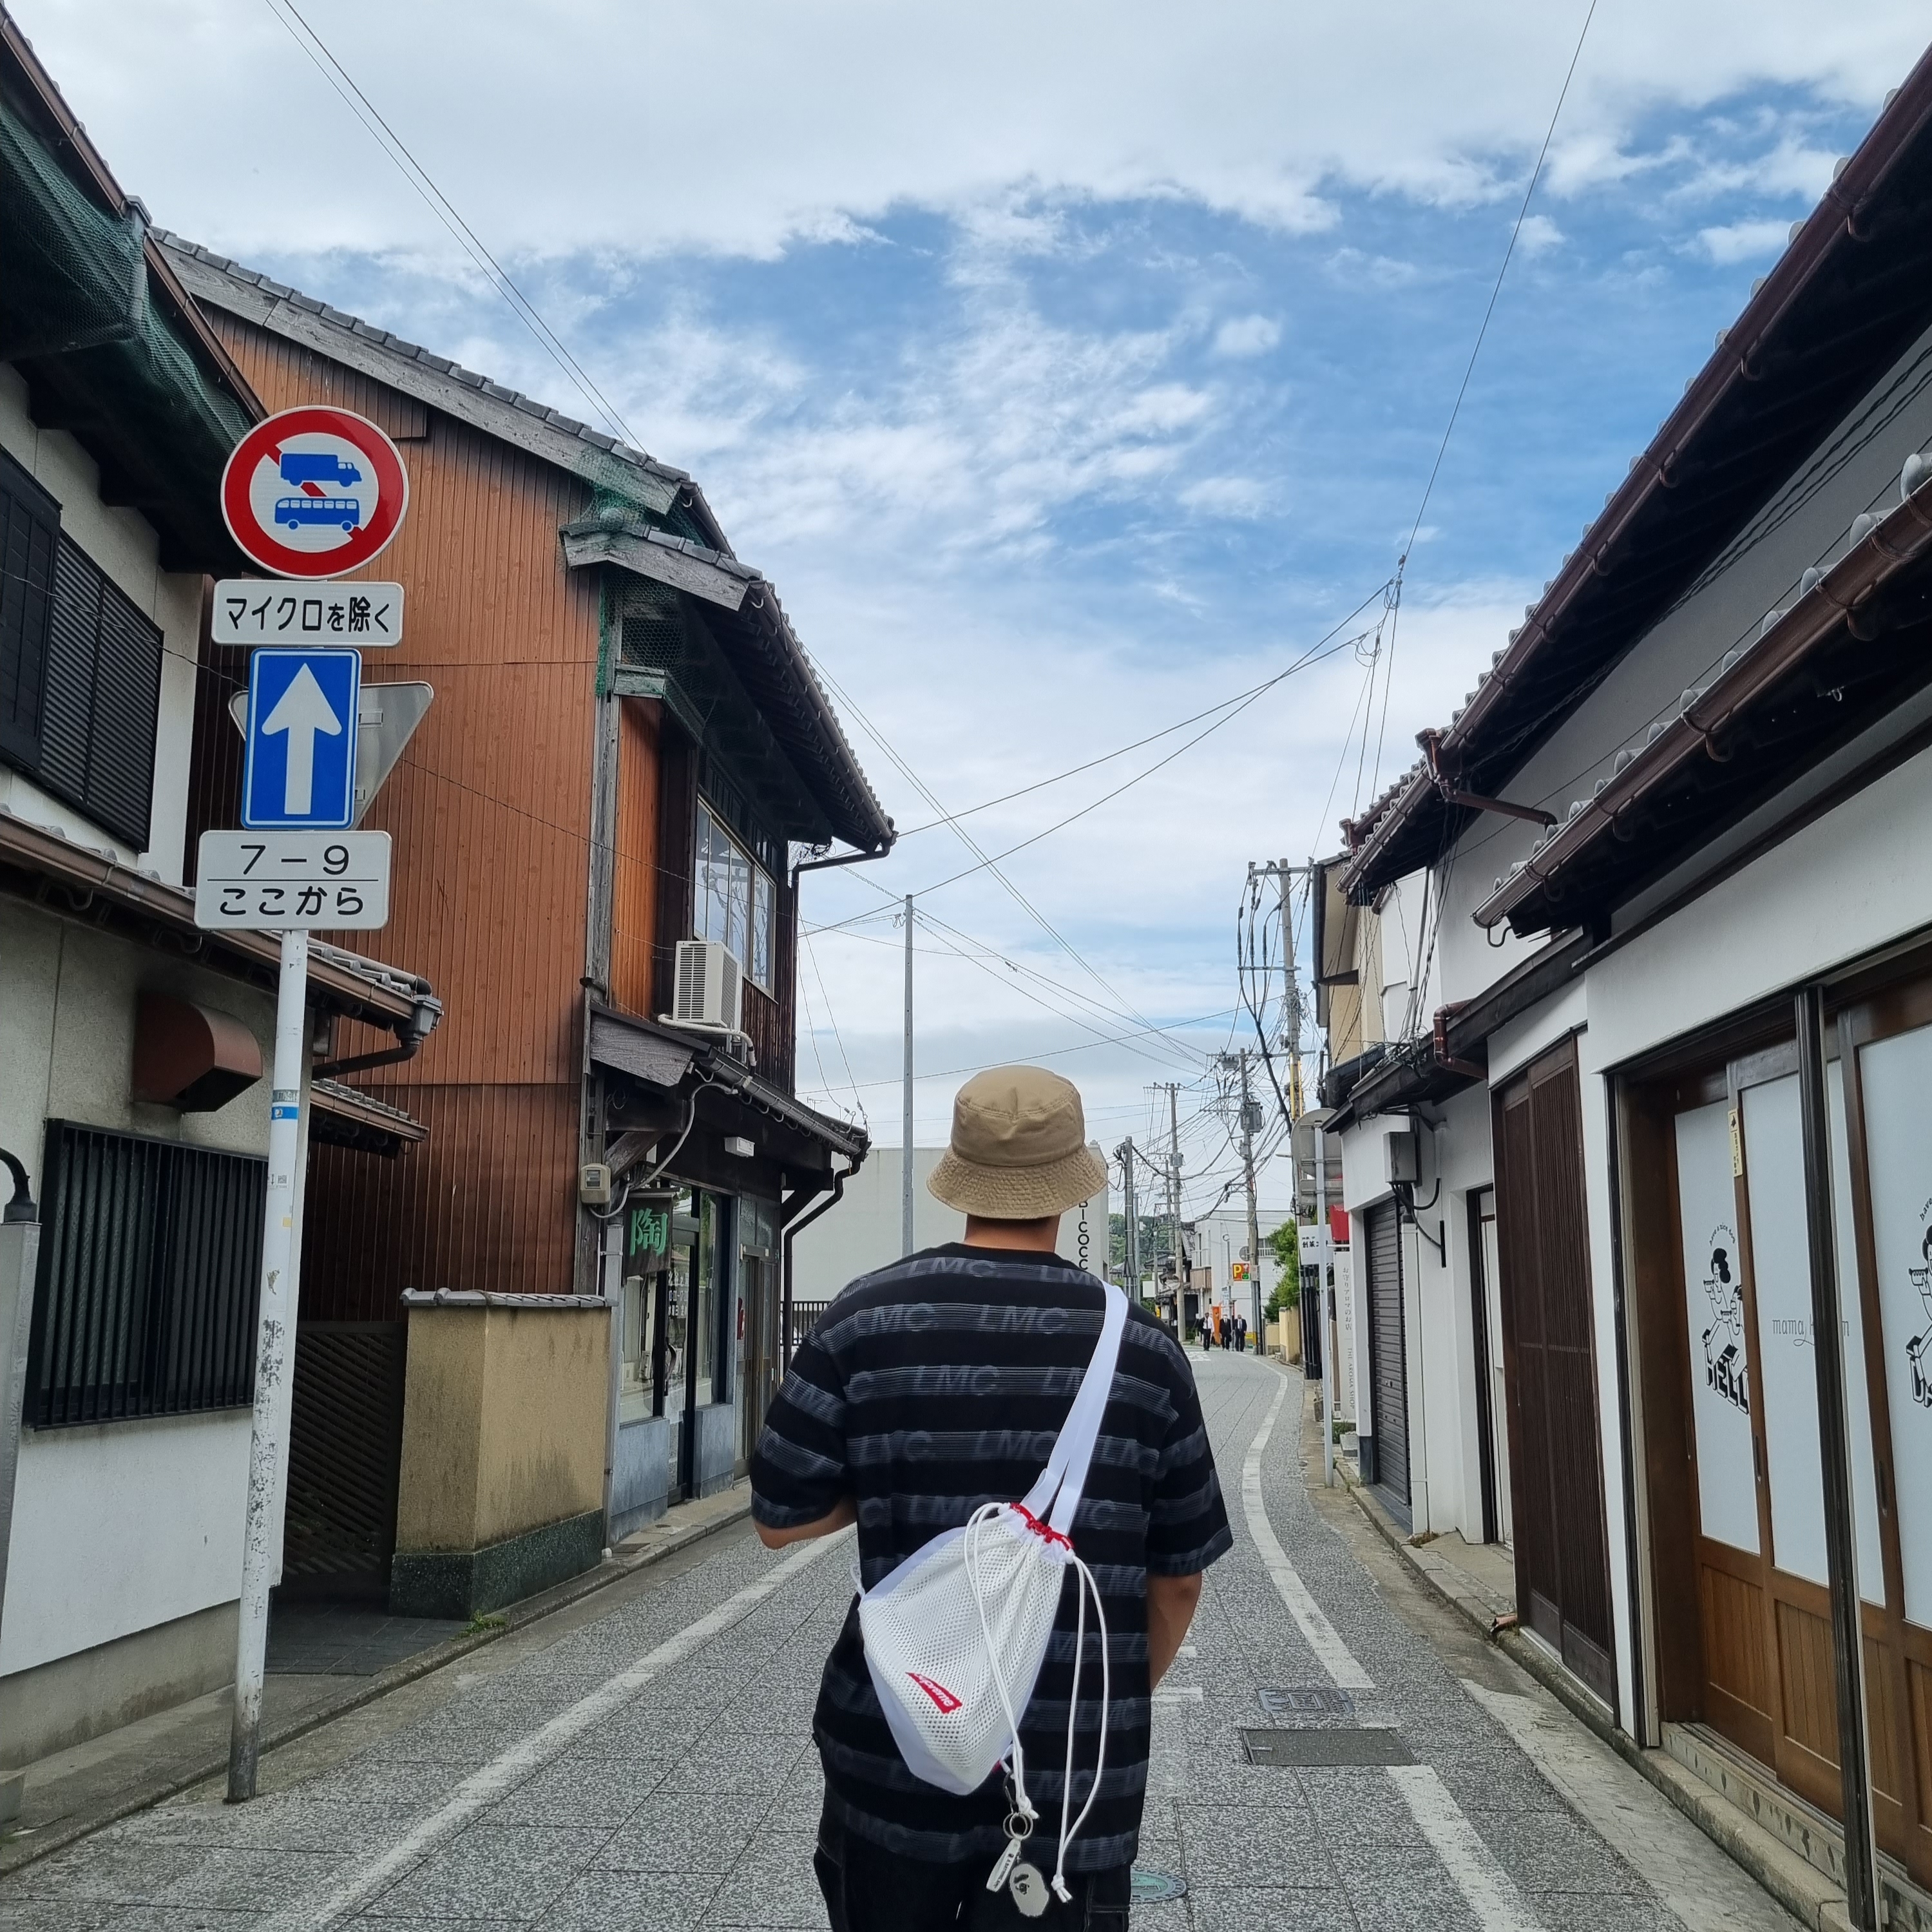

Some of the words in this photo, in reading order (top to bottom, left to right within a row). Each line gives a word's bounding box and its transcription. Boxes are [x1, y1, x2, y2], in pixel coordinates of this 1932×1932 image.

[225, 597, 389, 633] マイクロを除く
[219, 885, 364, 917] ここから
[629, 1207, 669, 1257] 陶
[1233, 1264, 1242, 1278] P
[1343, 1267, 1352, 1331] お守りアロマのお店
[1772, 1319, 1804, 1335] mama
[1704, 1342, 1750, 1415] HELL
